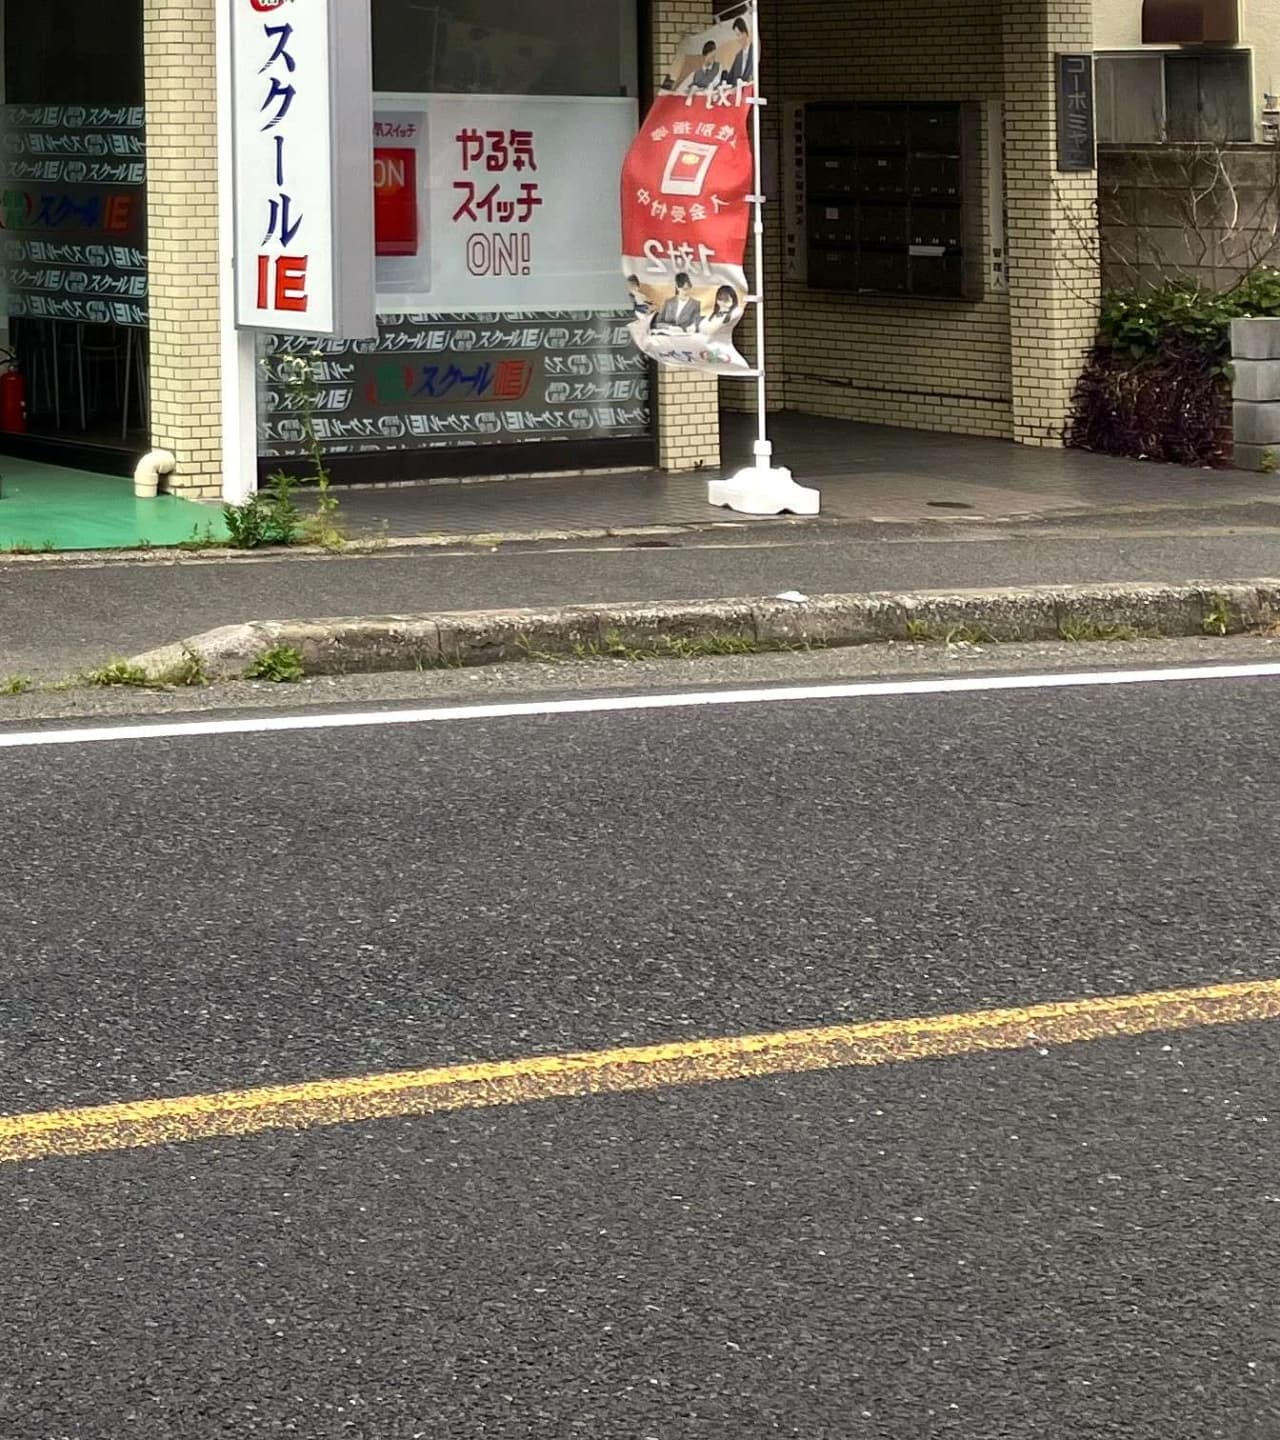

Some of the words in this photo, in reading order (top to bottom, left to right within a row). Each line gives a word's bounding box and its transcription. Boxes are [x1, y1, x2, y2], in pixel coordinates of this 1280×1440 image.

[374, 121, 417, 138] 気スイッチ
[456, 128, 537, 172] やる気
[453, 181, 543, 223] スイッチ
[466, 232, 532, 276] ON!
